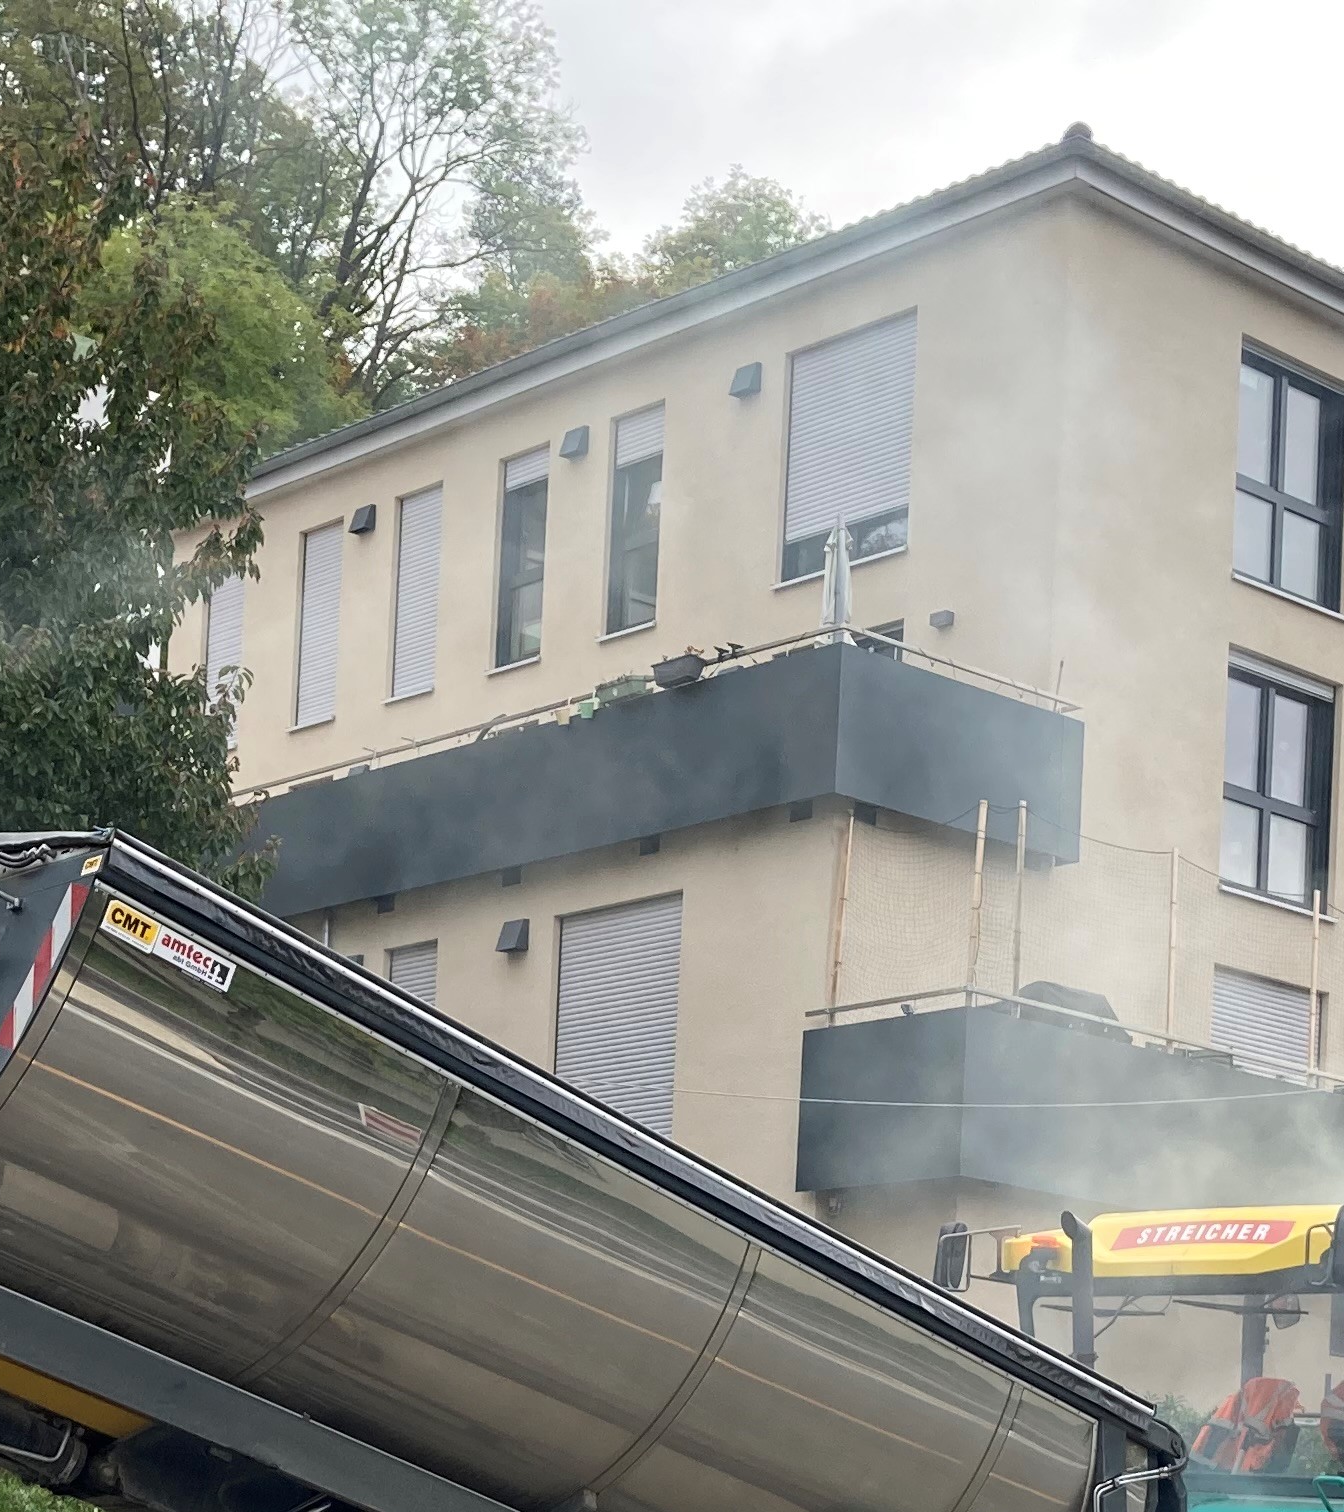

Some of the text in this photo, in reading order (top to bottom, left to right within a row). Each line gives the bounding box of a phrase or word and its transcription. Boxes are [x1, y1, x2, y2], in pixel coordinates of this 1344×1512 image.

[111, 907, 151, 939] CMT
[161, 934, 212, 969] amtec
[186, 960, 208, 977] GmbH
[1136, 1223, 1271, 1245] STREICHER
